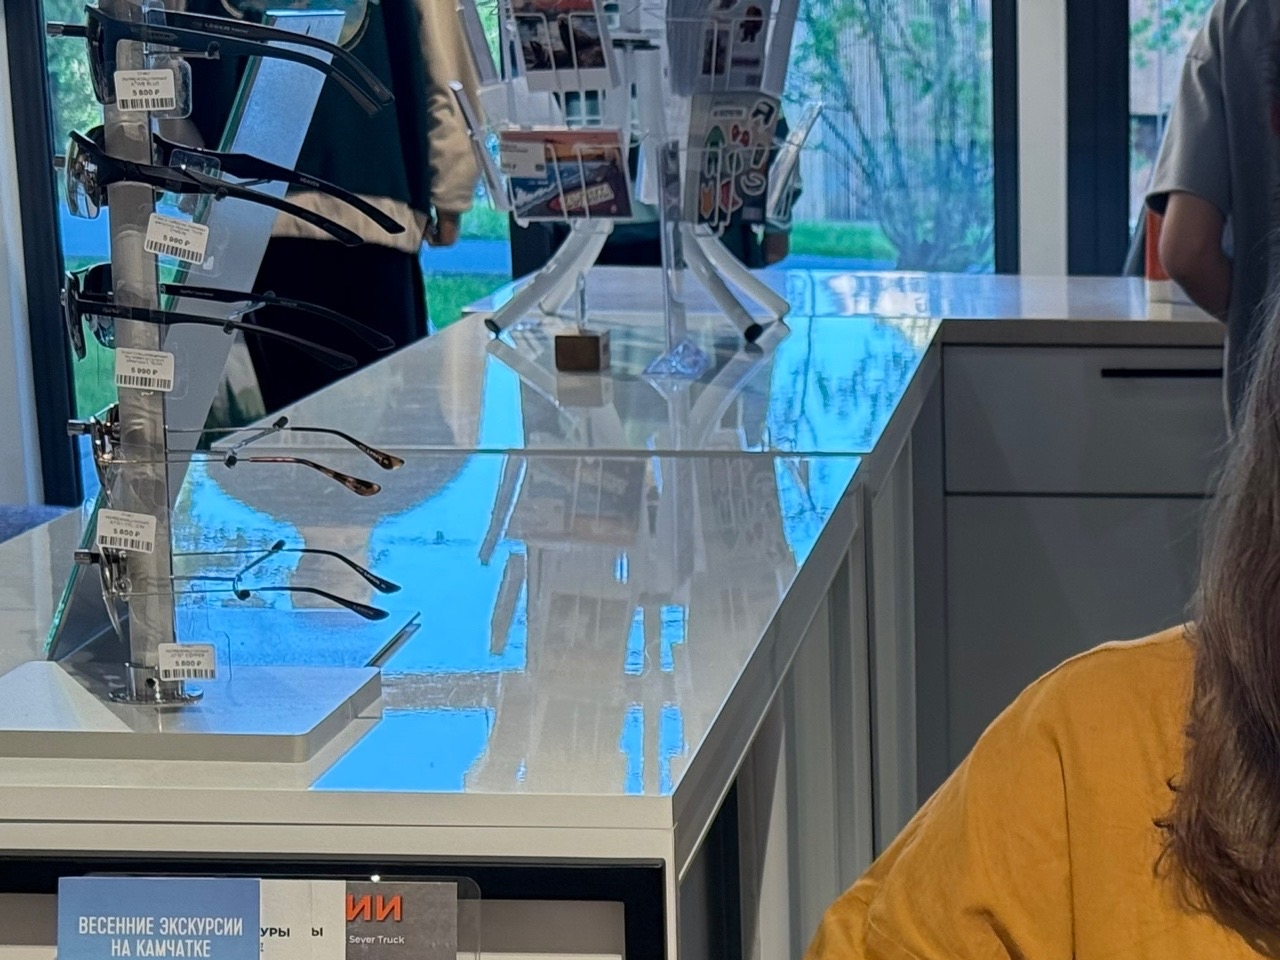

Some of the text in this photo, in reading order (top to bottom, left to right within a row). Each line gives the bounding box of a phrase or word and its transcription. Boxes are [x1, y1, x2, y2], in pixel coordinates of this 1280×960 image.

[78, 916, 243, 936] ВЕСЕННИЕ ЭКСКУРСИИ
[111, 938, 211, 958] НА КАМЧАТКЕ
[349, 935, 405, 944] Sever Truck
